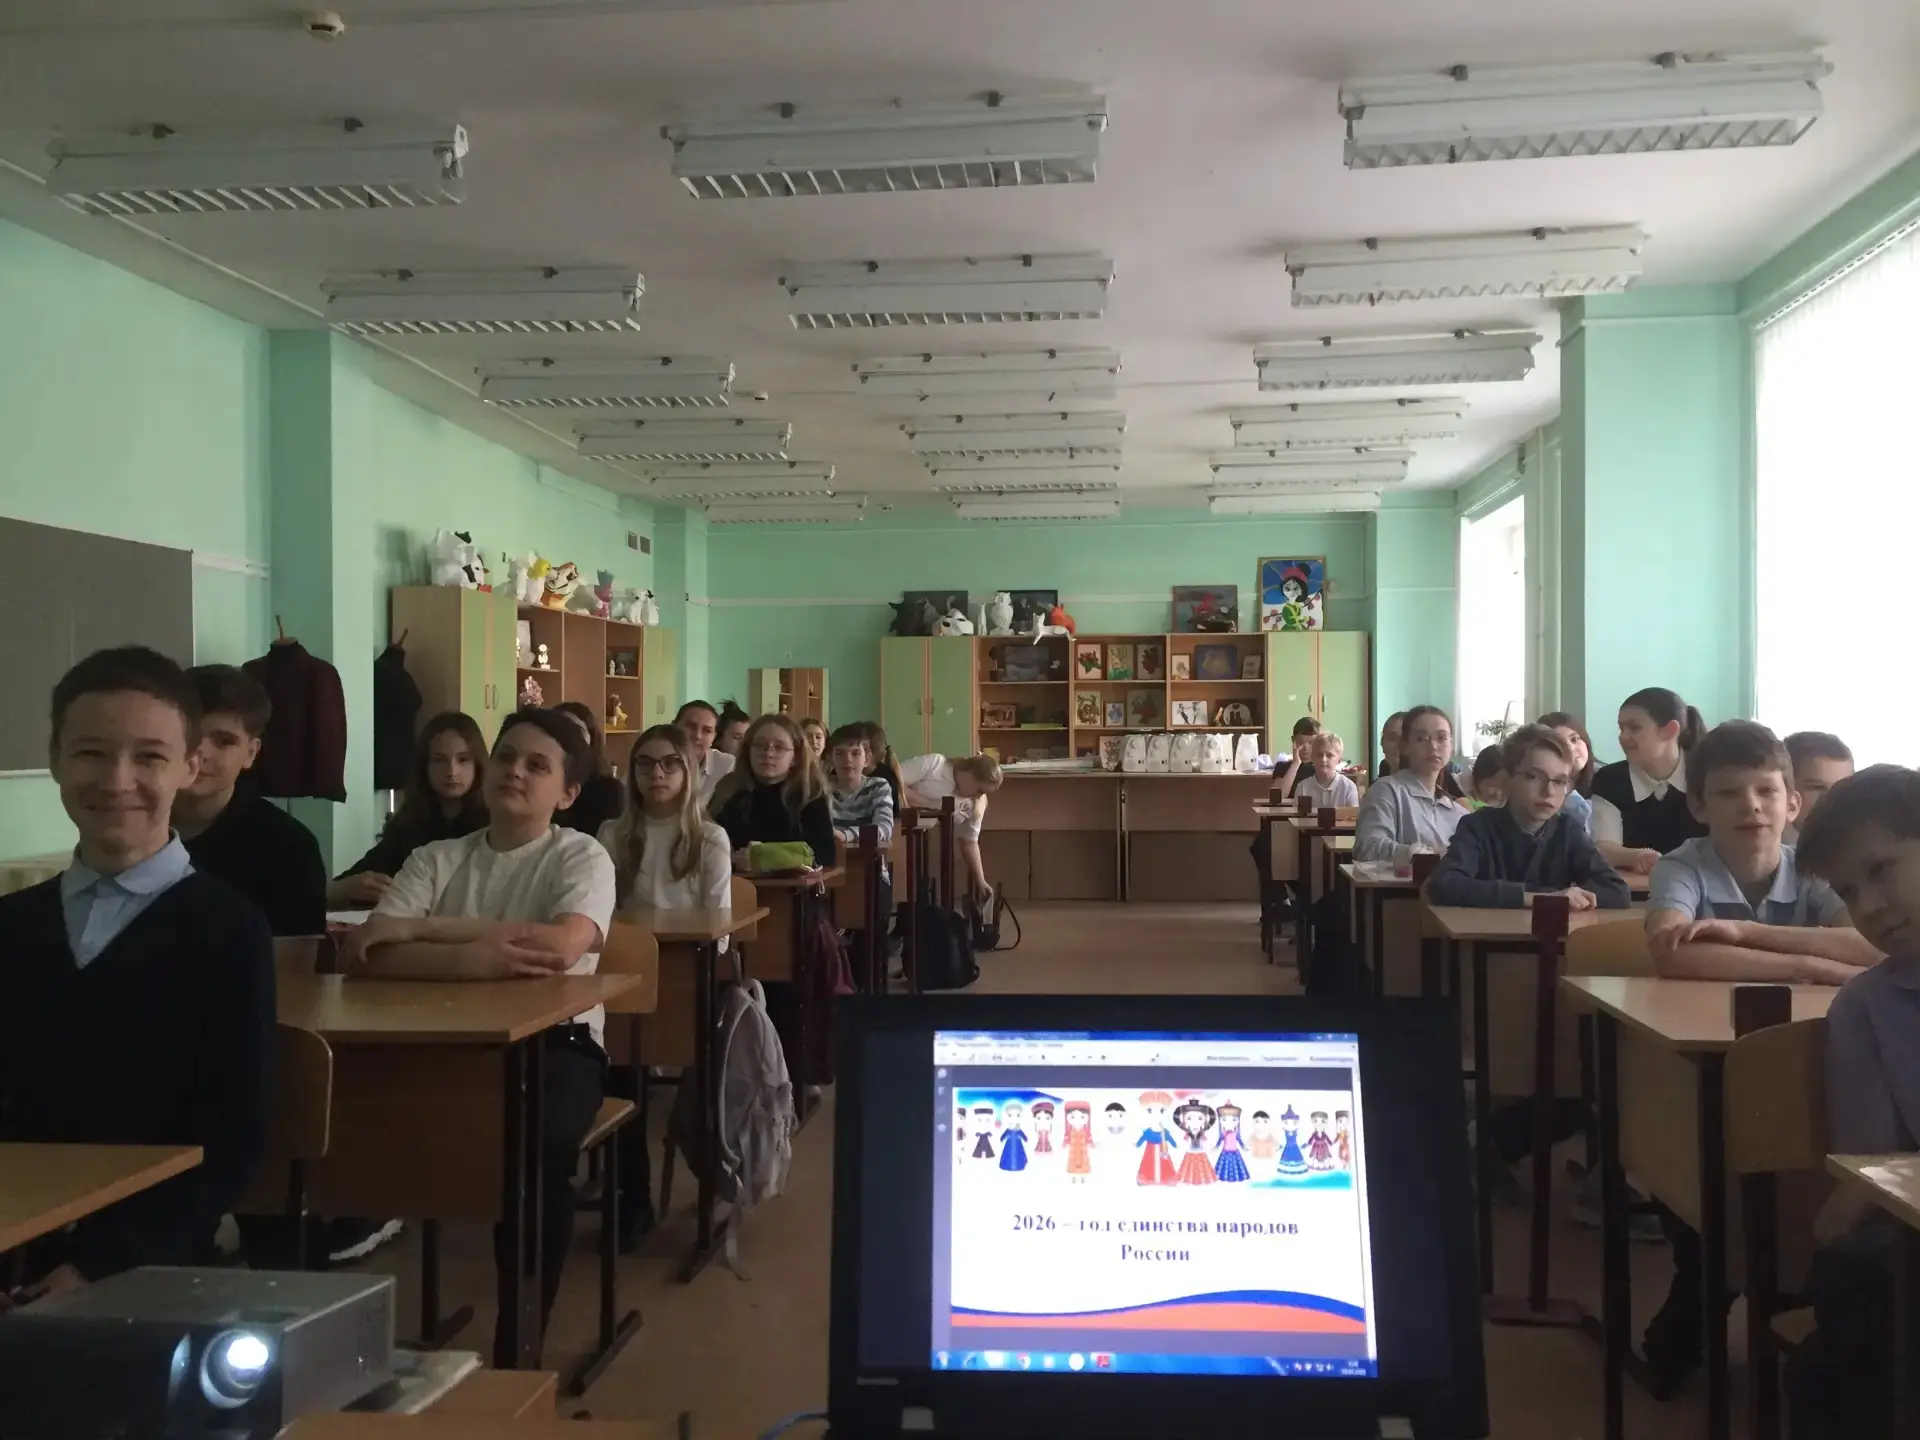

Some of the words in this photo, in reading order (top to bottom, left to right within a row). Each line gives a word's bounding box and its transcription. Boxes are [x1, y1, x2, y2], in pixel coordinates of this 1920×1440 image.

[1012, 1214, 1056, 1231] 2026
[1215, 1222, 1299, 1239] народов
[1121, 1244, 1190, 1261] России
